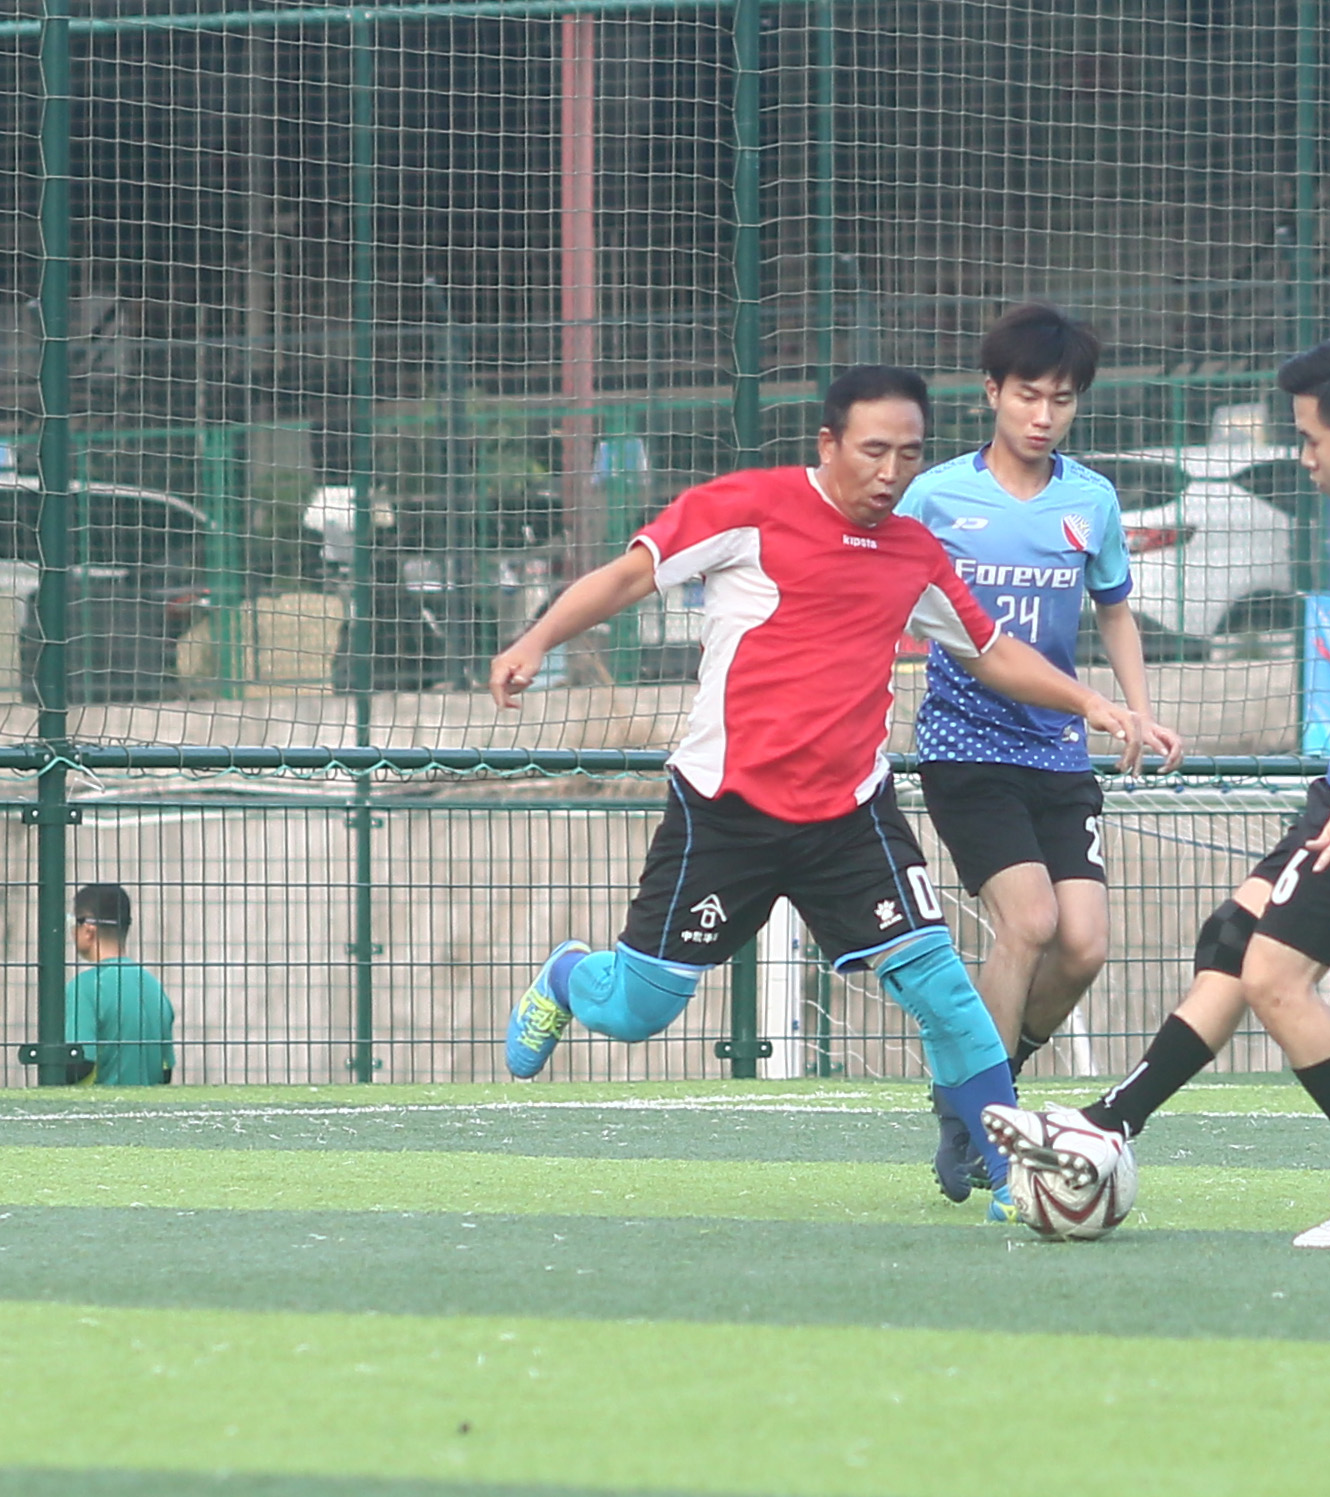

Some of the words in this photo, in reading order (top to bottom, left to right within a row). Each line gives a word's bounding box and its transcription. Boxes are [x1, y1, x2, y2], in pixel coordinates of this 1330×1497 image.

[842, 534, 877, 549] kipsta
[955, 558, 1081, 588] Forever
[996, 595, 1041, 644] 24
[906, 866, 943, 919] 0
[1271, 848, 1309, 904] 6
